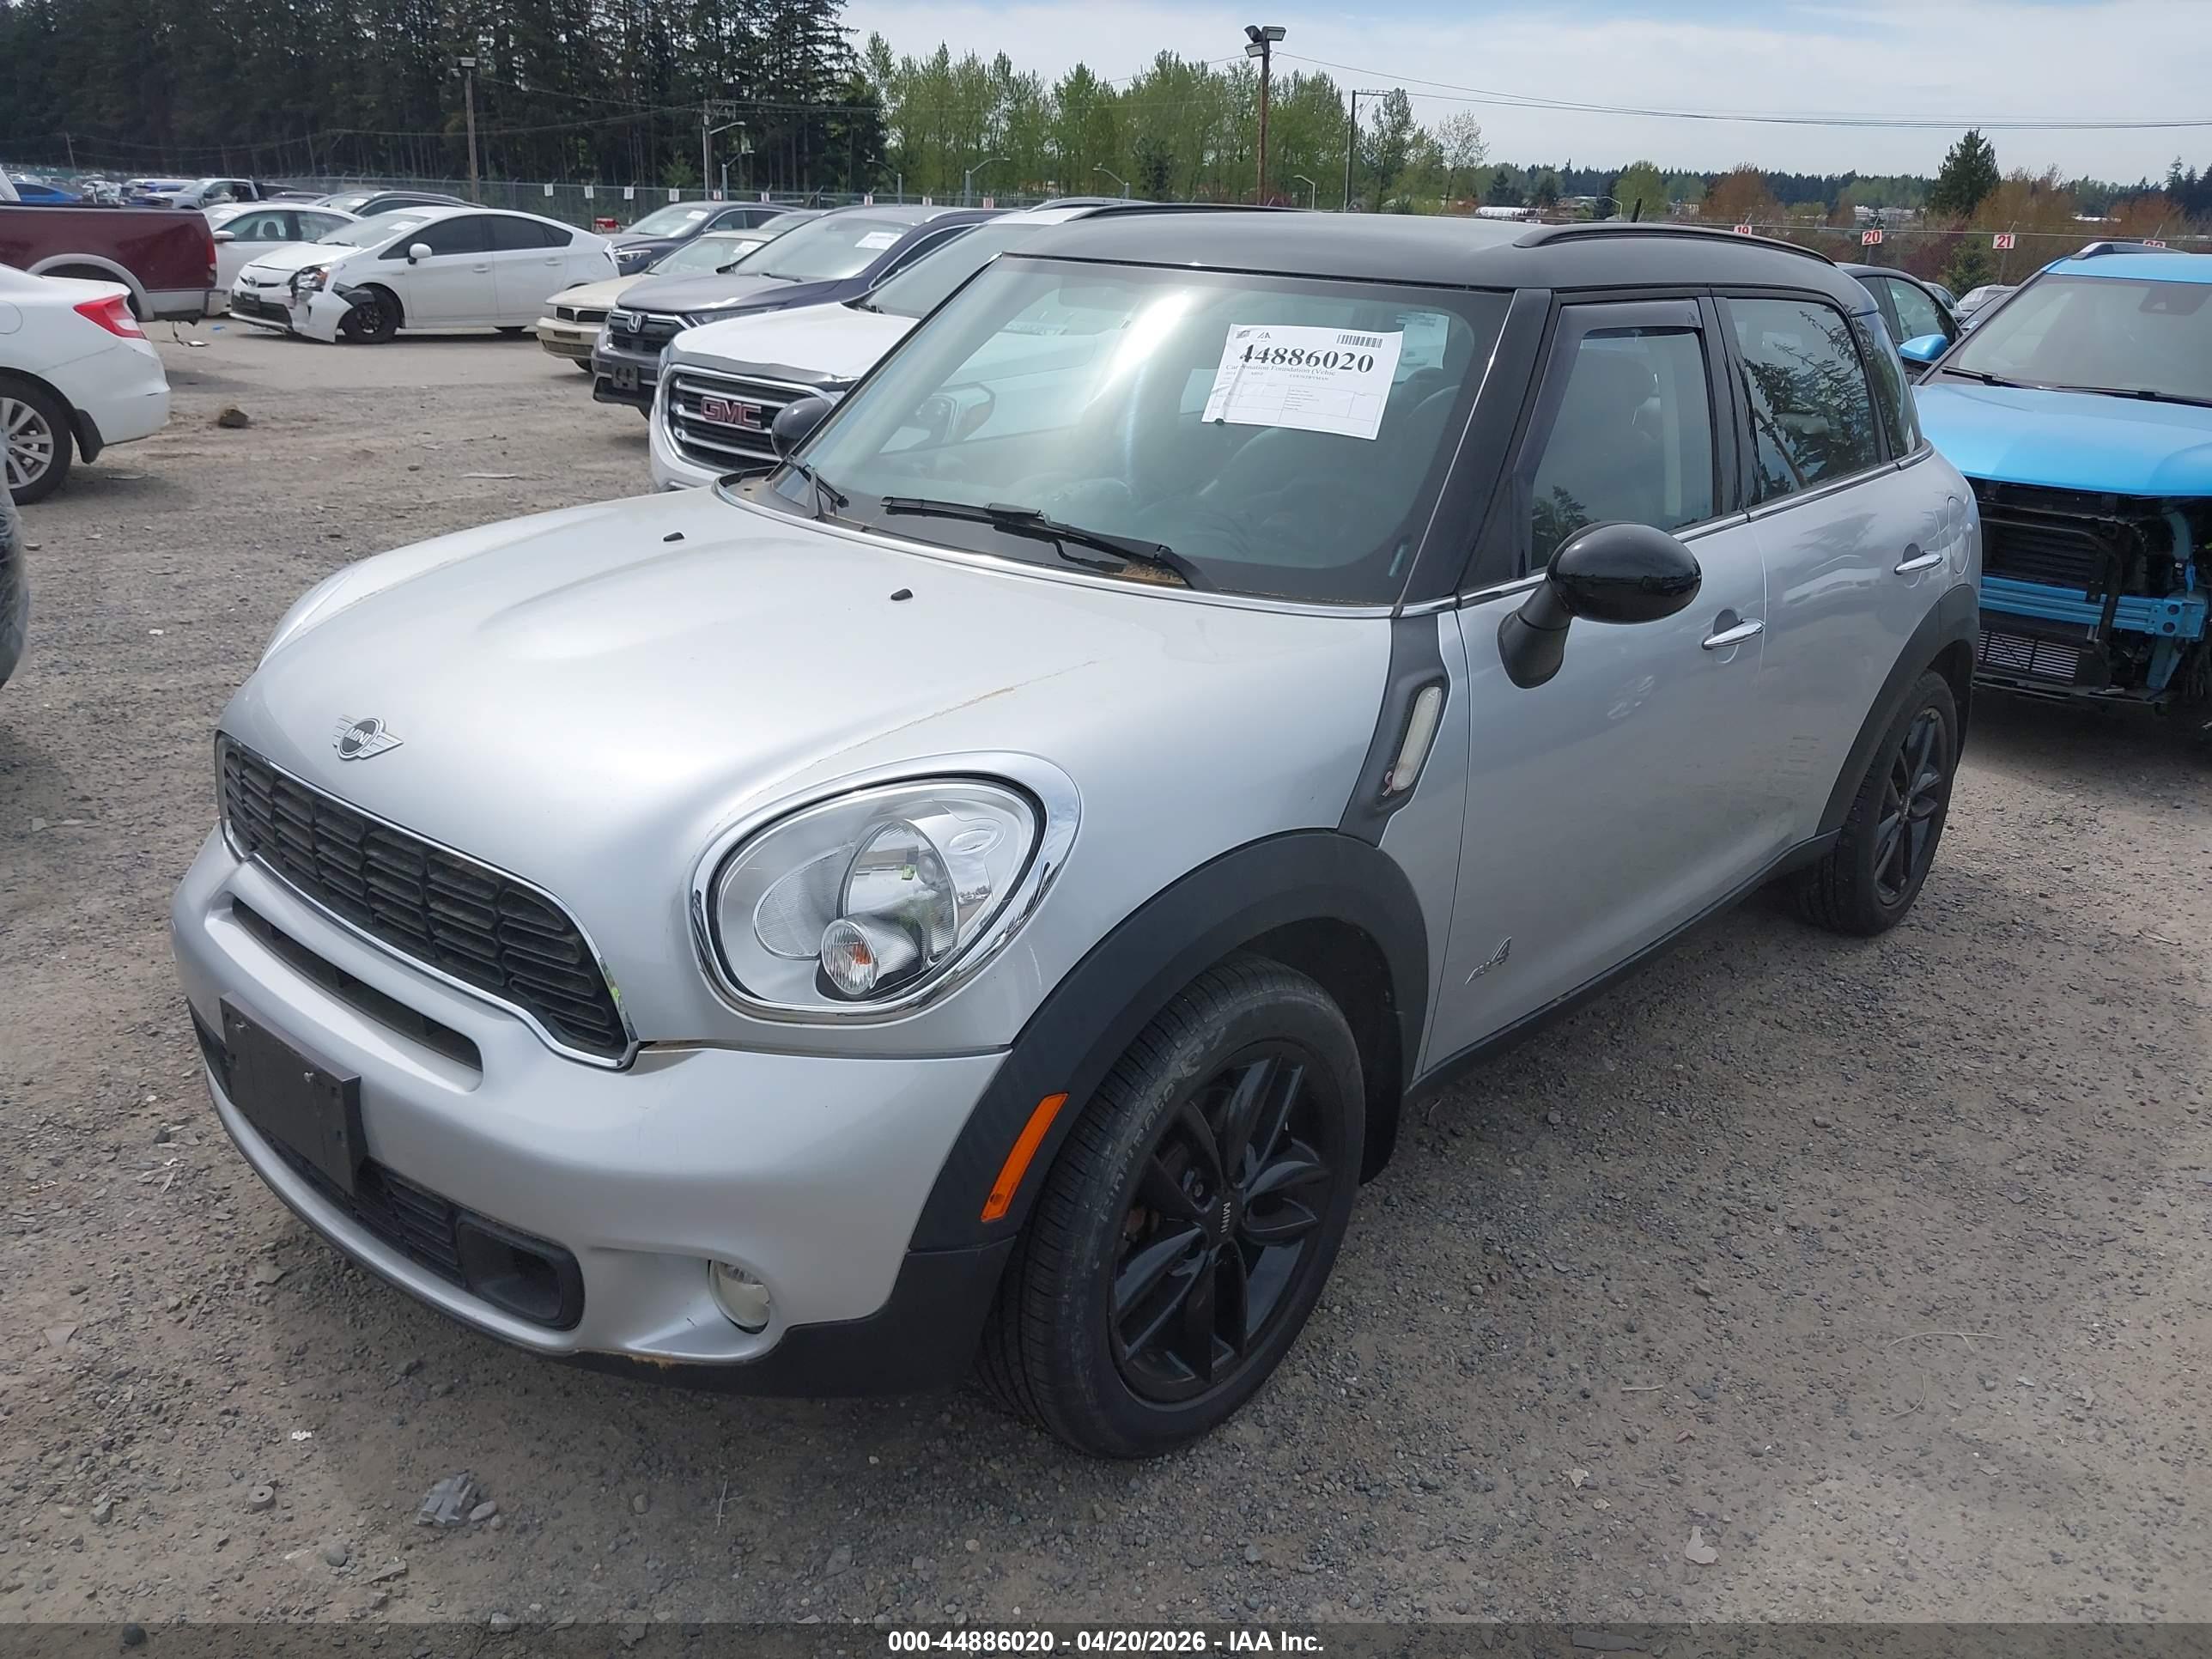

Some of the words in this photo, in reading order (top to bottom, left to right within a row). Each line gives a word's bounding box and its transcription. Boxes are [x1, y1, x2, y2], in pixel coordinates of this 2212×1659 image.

[1863, 231, 1881, 244] 20
[1996, 235, 2012, 248] 21
[1239, 343, 1374, 374] 44886020
[701, 396, 762, 429] GMC
[1220, 1201, 1231, 1233] MINI
